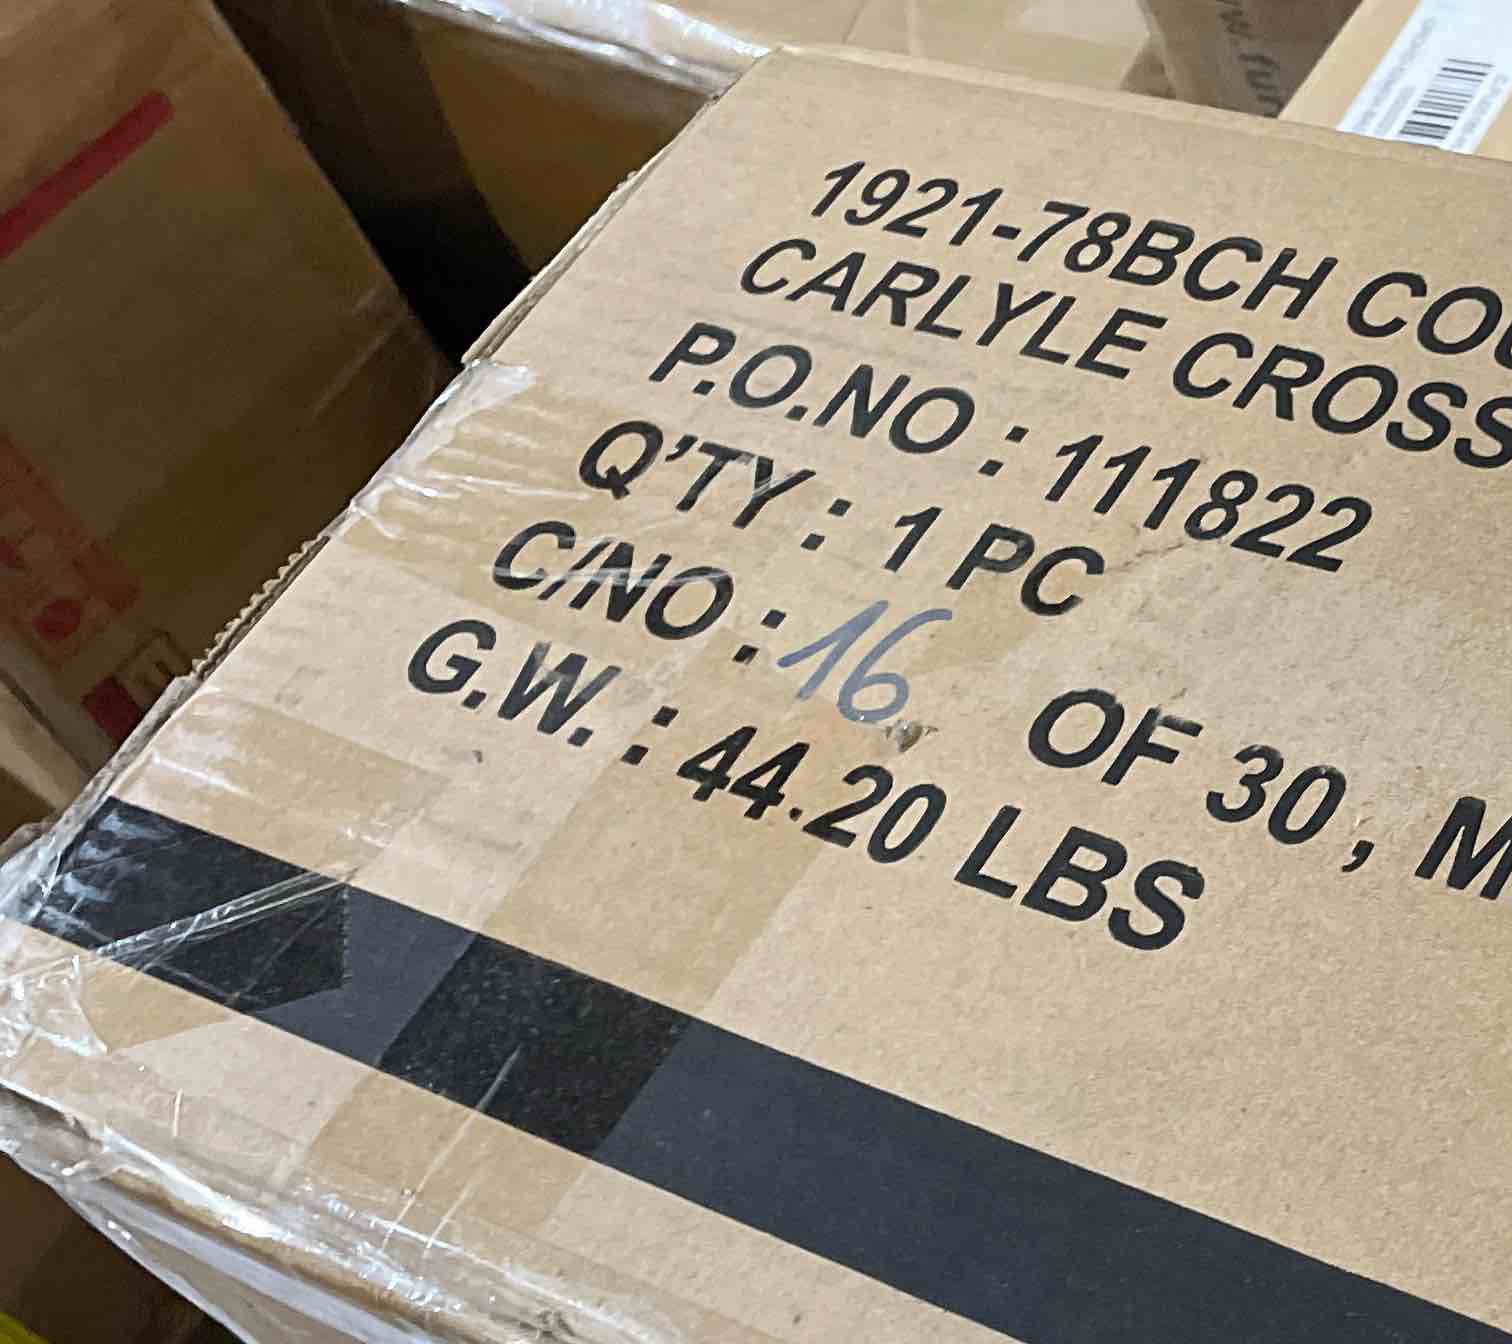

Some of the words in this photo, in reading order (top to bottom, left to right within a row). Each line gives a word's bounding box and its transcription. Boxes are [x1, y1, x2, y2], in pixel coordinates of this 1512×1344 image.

[740, 238, 1167, 380] CARLYLE
[811, 160, 1338, 319] 1921-78BCH
[884, 506, 943, 573] 1
[946, 523, 1105, 616] PC
[1044, 433, 1373, 572] 111822
[777, 599, 952, 725] 16
[1027, 687, 1203, 787] OF
[676, 725, 947, 864] 44.20
[955, 804, 1206, 950] LBS
